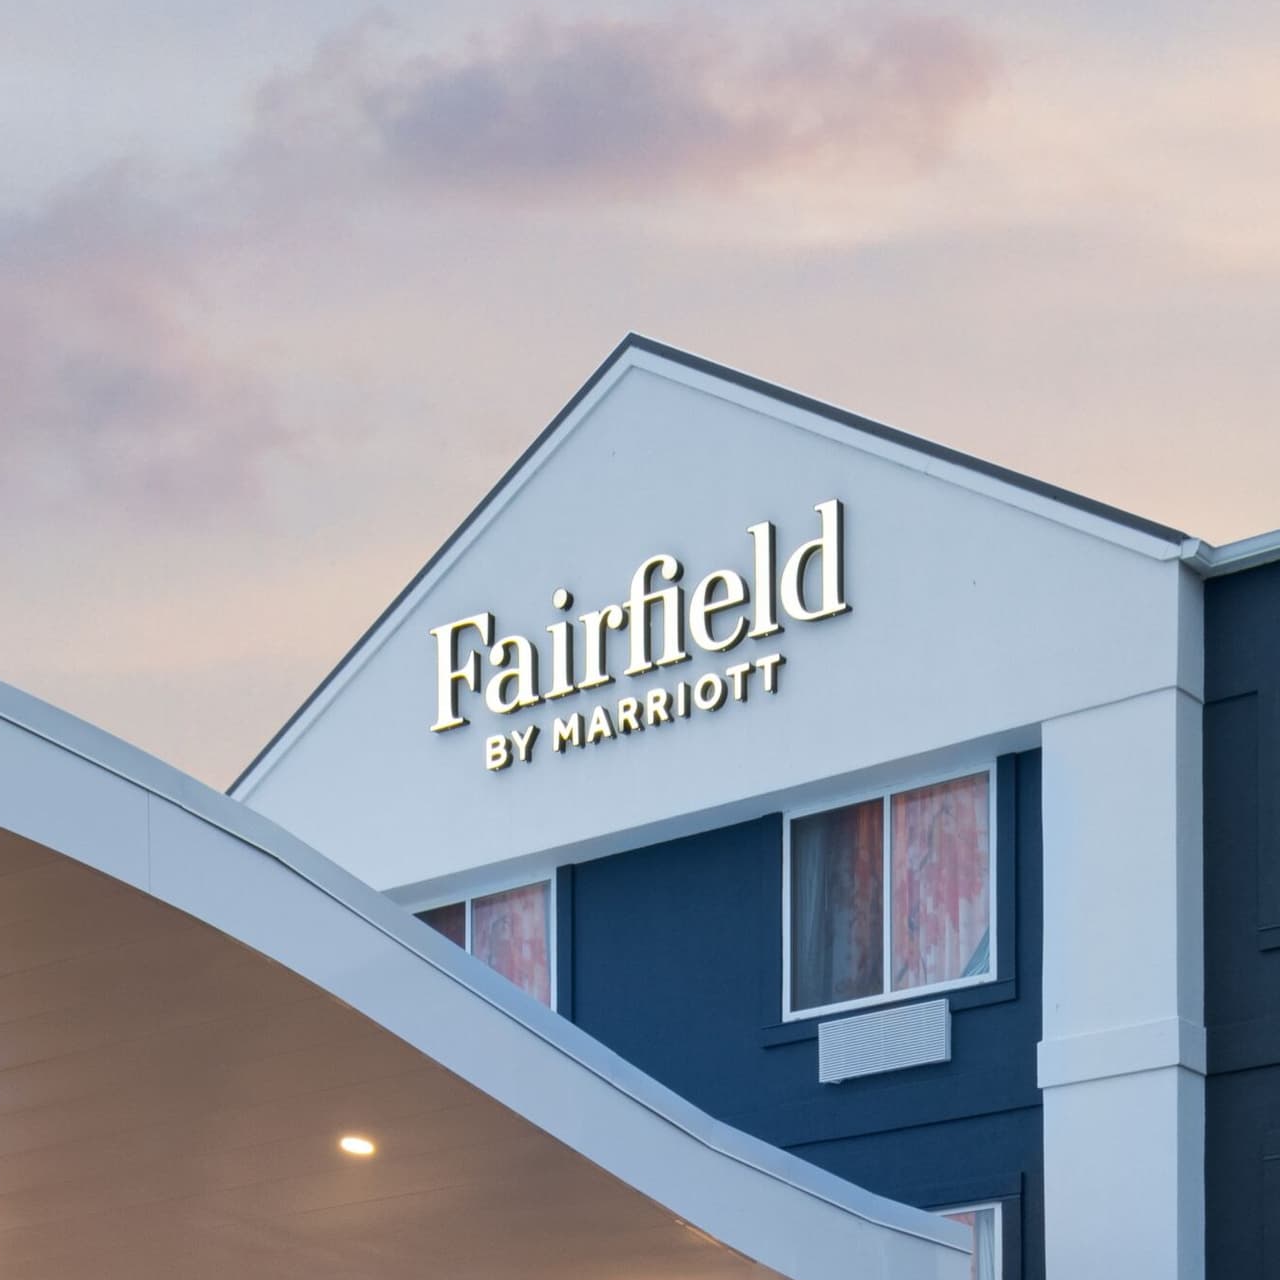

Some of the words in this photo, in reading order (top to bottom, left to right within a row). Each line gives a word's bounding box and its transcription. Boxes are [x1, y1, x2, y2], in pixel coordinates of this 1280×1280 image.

[429, 498, 852, 733] Fairfield
[485, 725, 540, 771] BY
[552, 653, 786, 752] MARRIOTT
